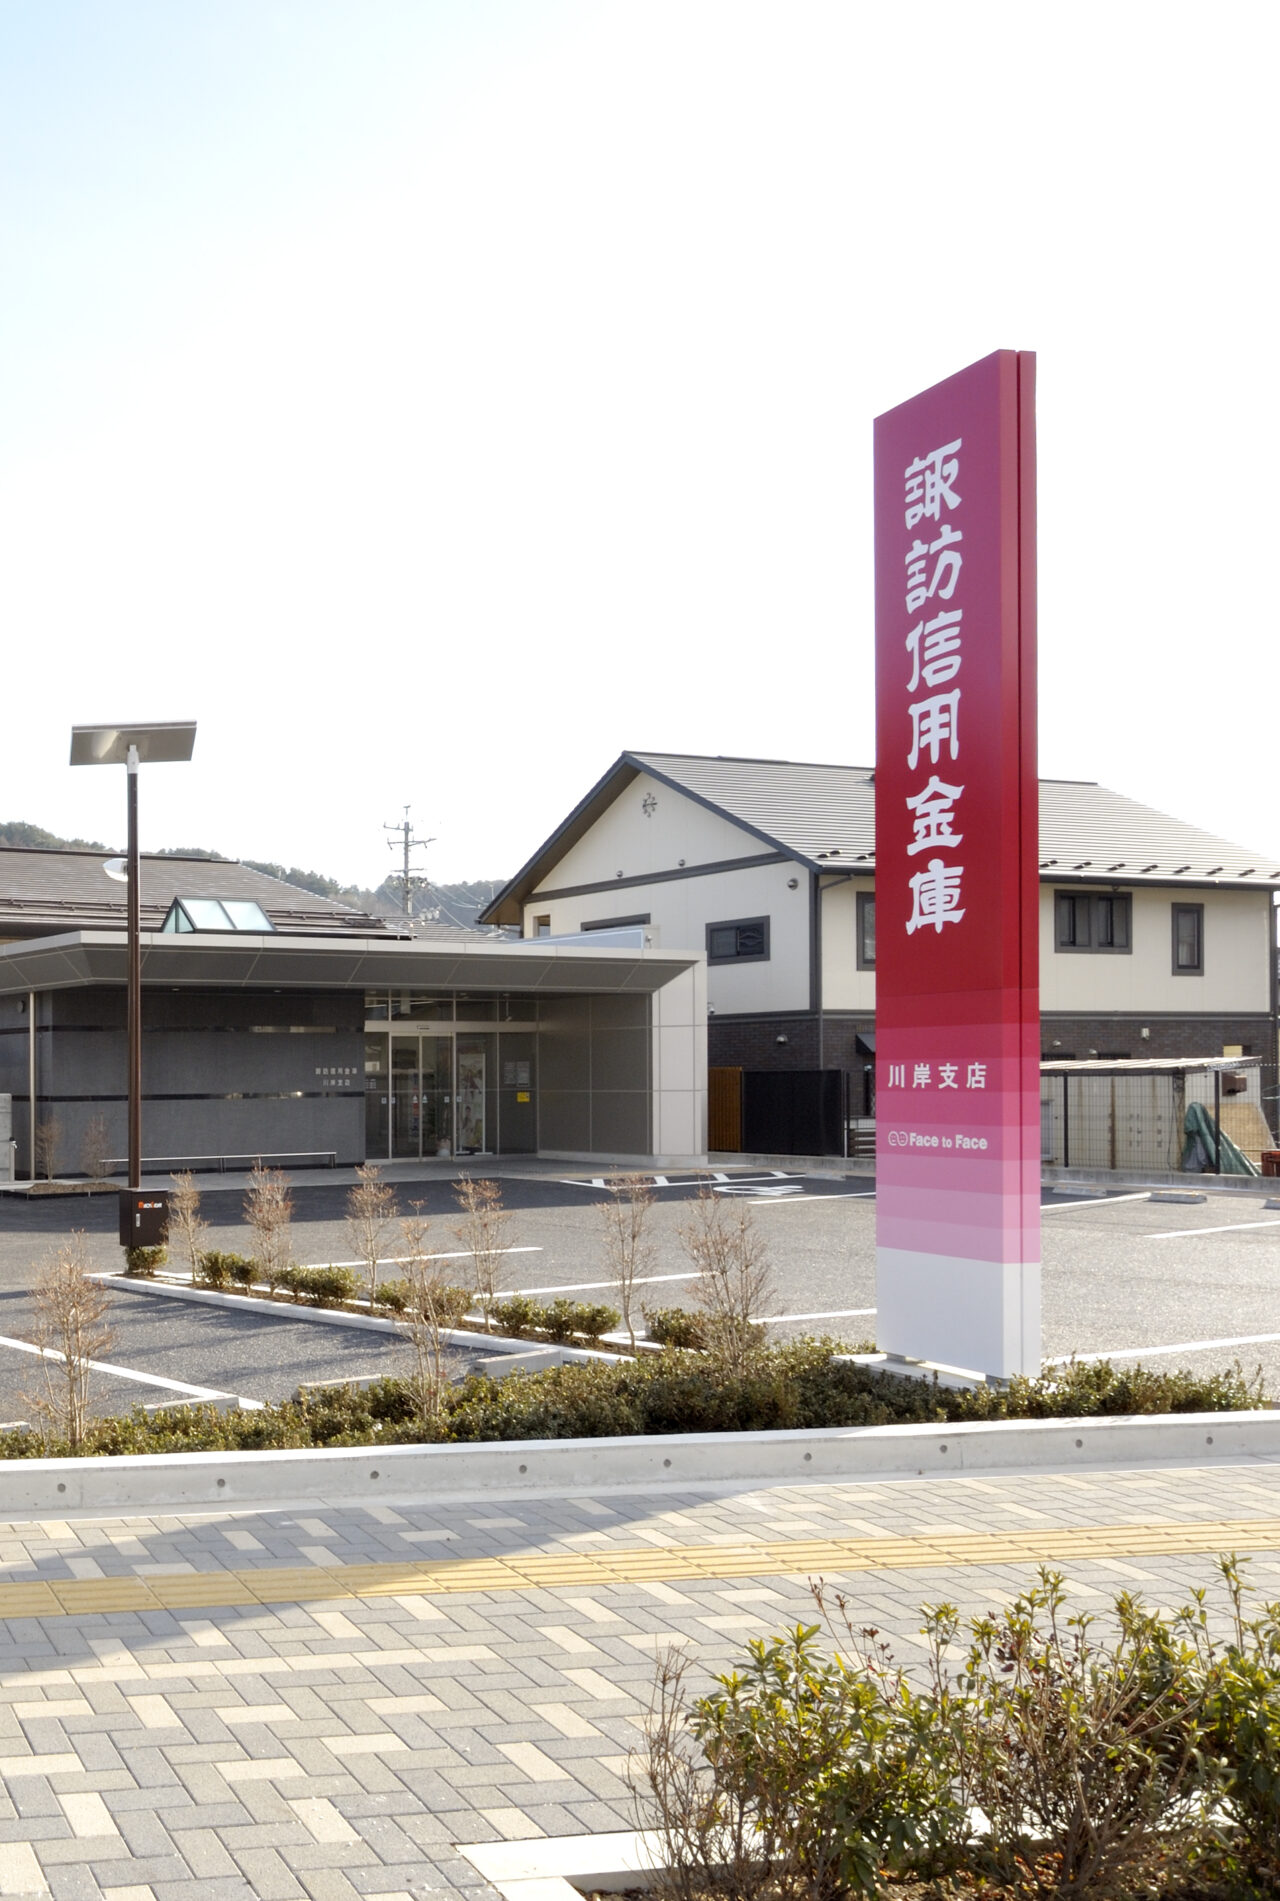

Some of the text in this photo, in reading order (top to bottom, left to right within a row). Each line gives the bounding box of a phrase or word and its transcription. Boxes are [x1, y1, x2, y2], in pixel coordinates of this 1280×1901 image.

[904, 437, 967, 935] 諏訪信用金庫
[887, 1062, 987, 1089] 川岸支店
[909, 1132, 988, 1150] Face to Face
